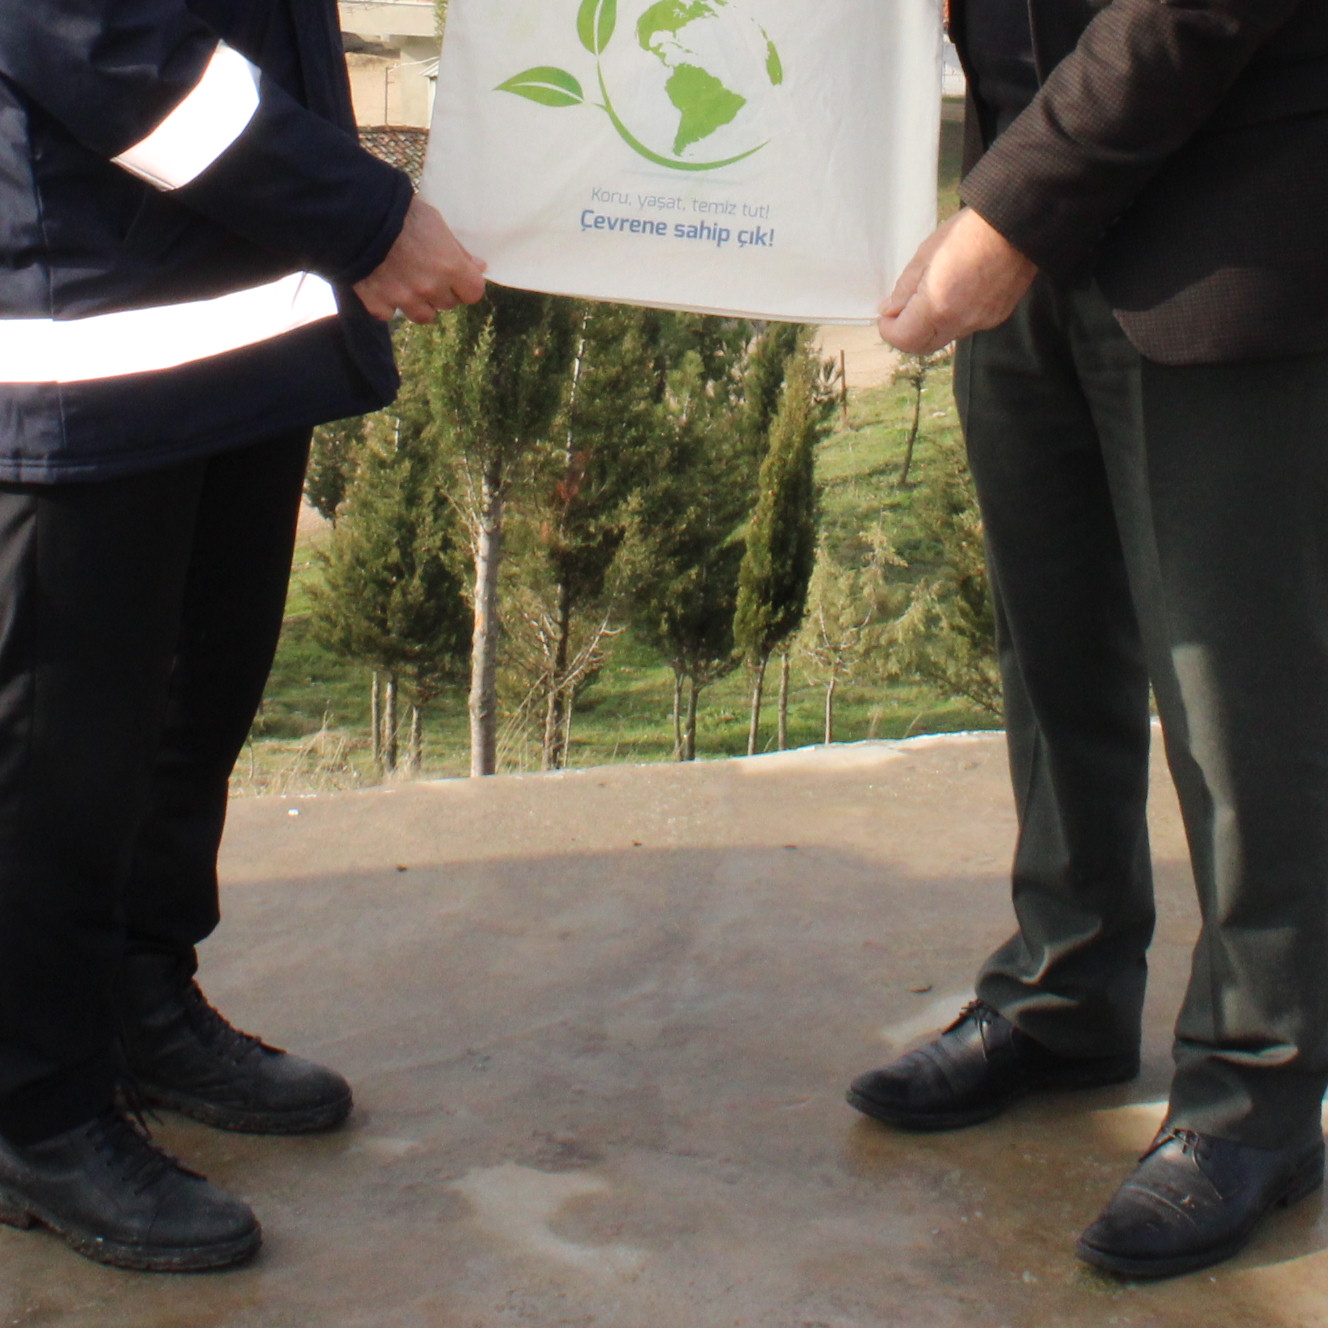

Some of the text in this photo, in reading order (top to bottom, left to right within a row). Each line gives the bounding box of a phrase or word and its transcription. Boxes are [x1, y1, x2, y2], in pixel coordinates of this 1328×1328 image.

[591, 187, 632, 206] Koru,
[692, 199, 737, 215] temiz
[742, 204, 770, 219] tut!
[580, 209, 775, 248] Çevrene sahip çık!
